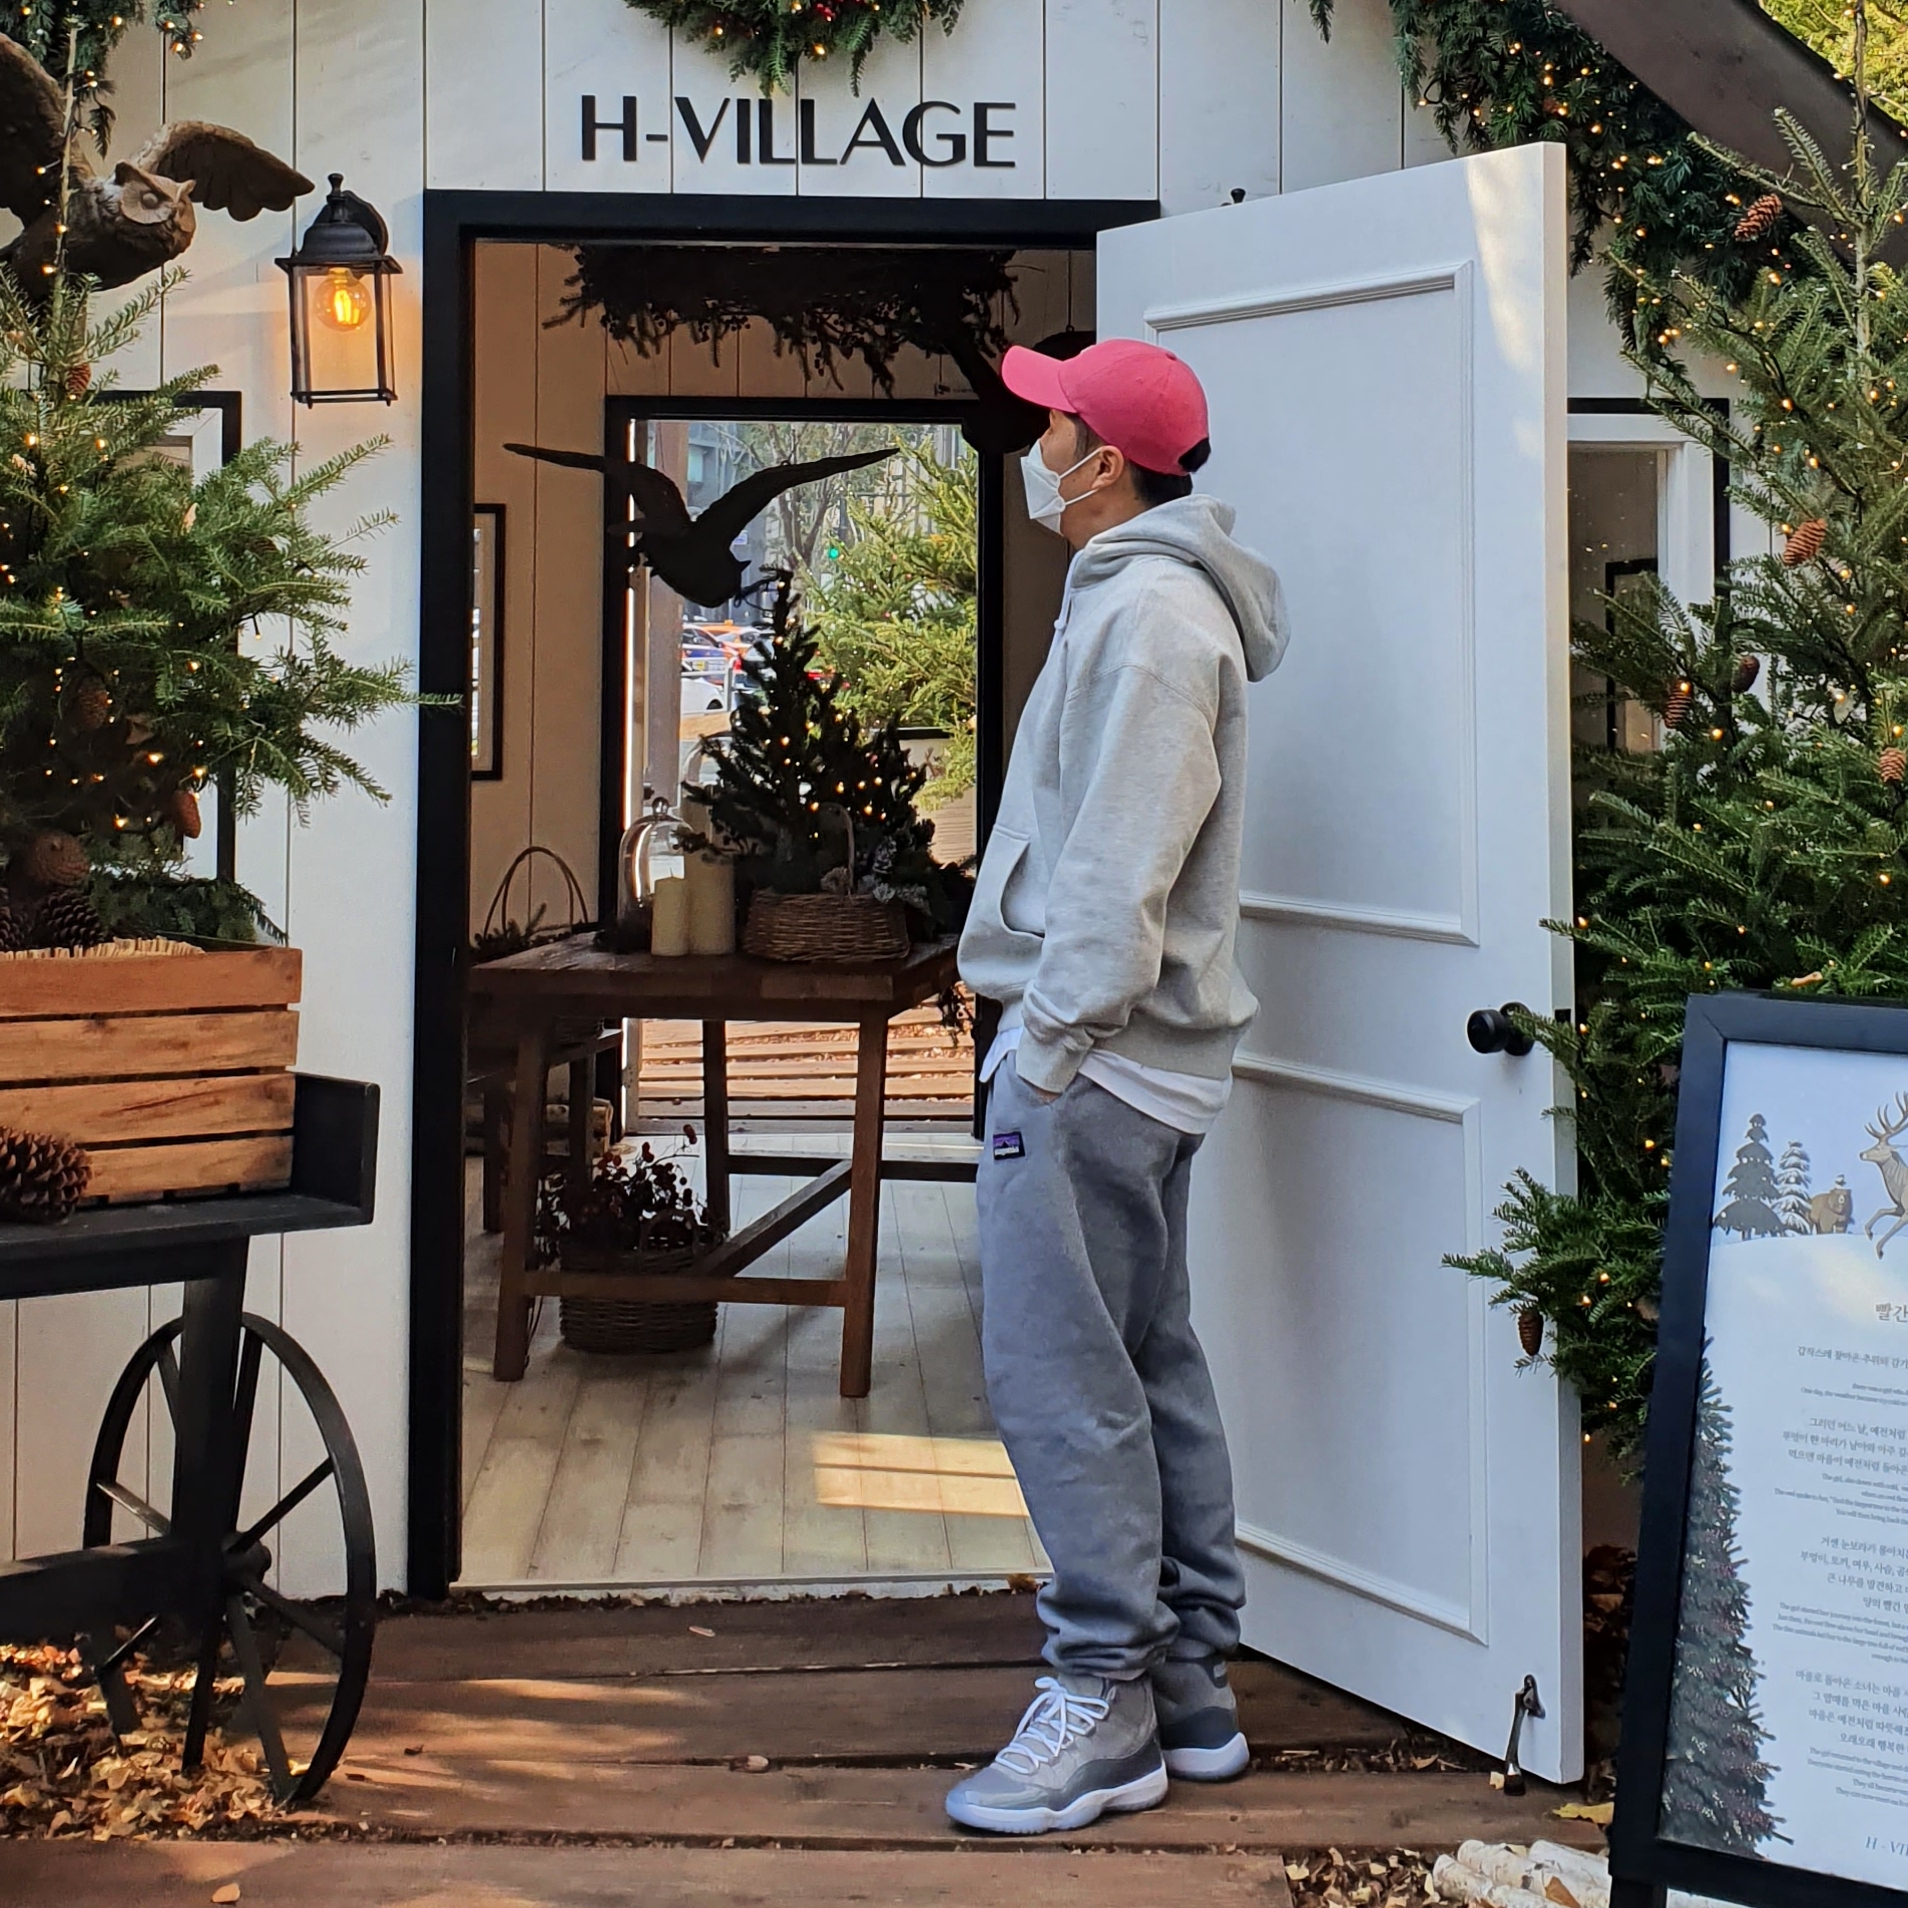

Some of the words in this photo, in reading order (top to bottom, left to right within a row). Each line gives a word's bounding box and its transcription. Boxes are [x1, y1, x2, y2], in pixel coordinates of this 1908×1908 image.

[581, 94, 1016, 168] H-VILLAGE
[1875, 1302, 1908, 1323] 빨간
[1821, 1436, 1847, 1450] 마리가
[1877, 1444, 1896, 1456] 아주
[1866, 1578, 1904, 1595] 발견하고
[1853, 1680, 1882, 1696] 소녀는
[1877, 1739, 1905, 1755] 행복한
[1865, 1835, 1877, 1850] H
